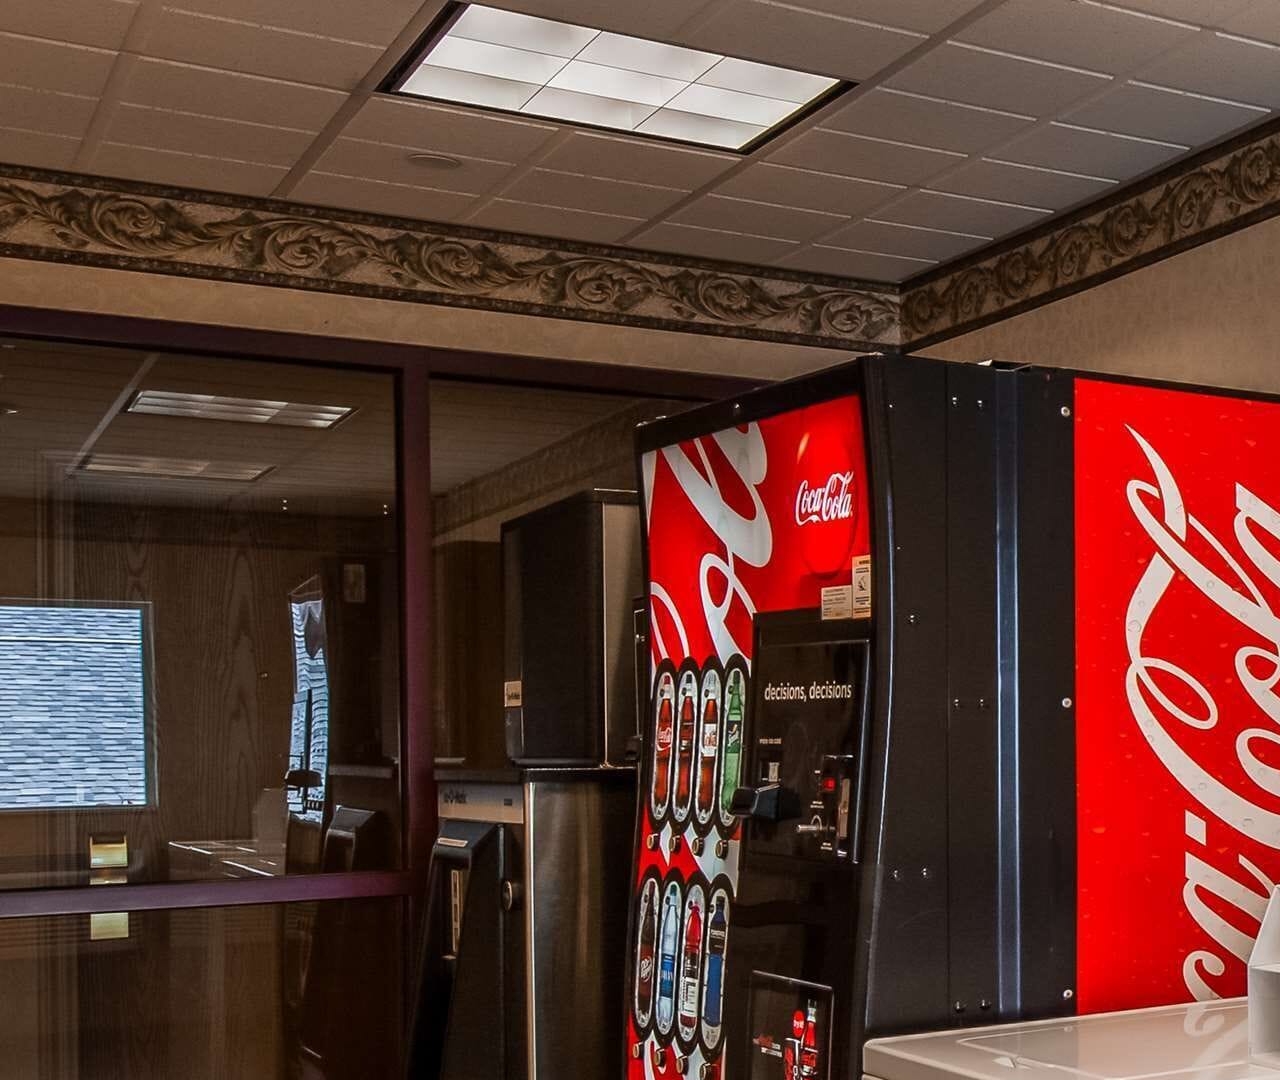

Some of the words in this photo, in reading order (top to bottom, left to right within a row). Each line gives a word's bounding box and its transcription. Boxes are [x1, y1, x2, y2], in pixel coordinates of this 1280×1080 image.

[796, 471, 854, 526] Coca-Cola
[764, 682, 807, 702] decisions,
[809, 681, 852, 699] decisions
